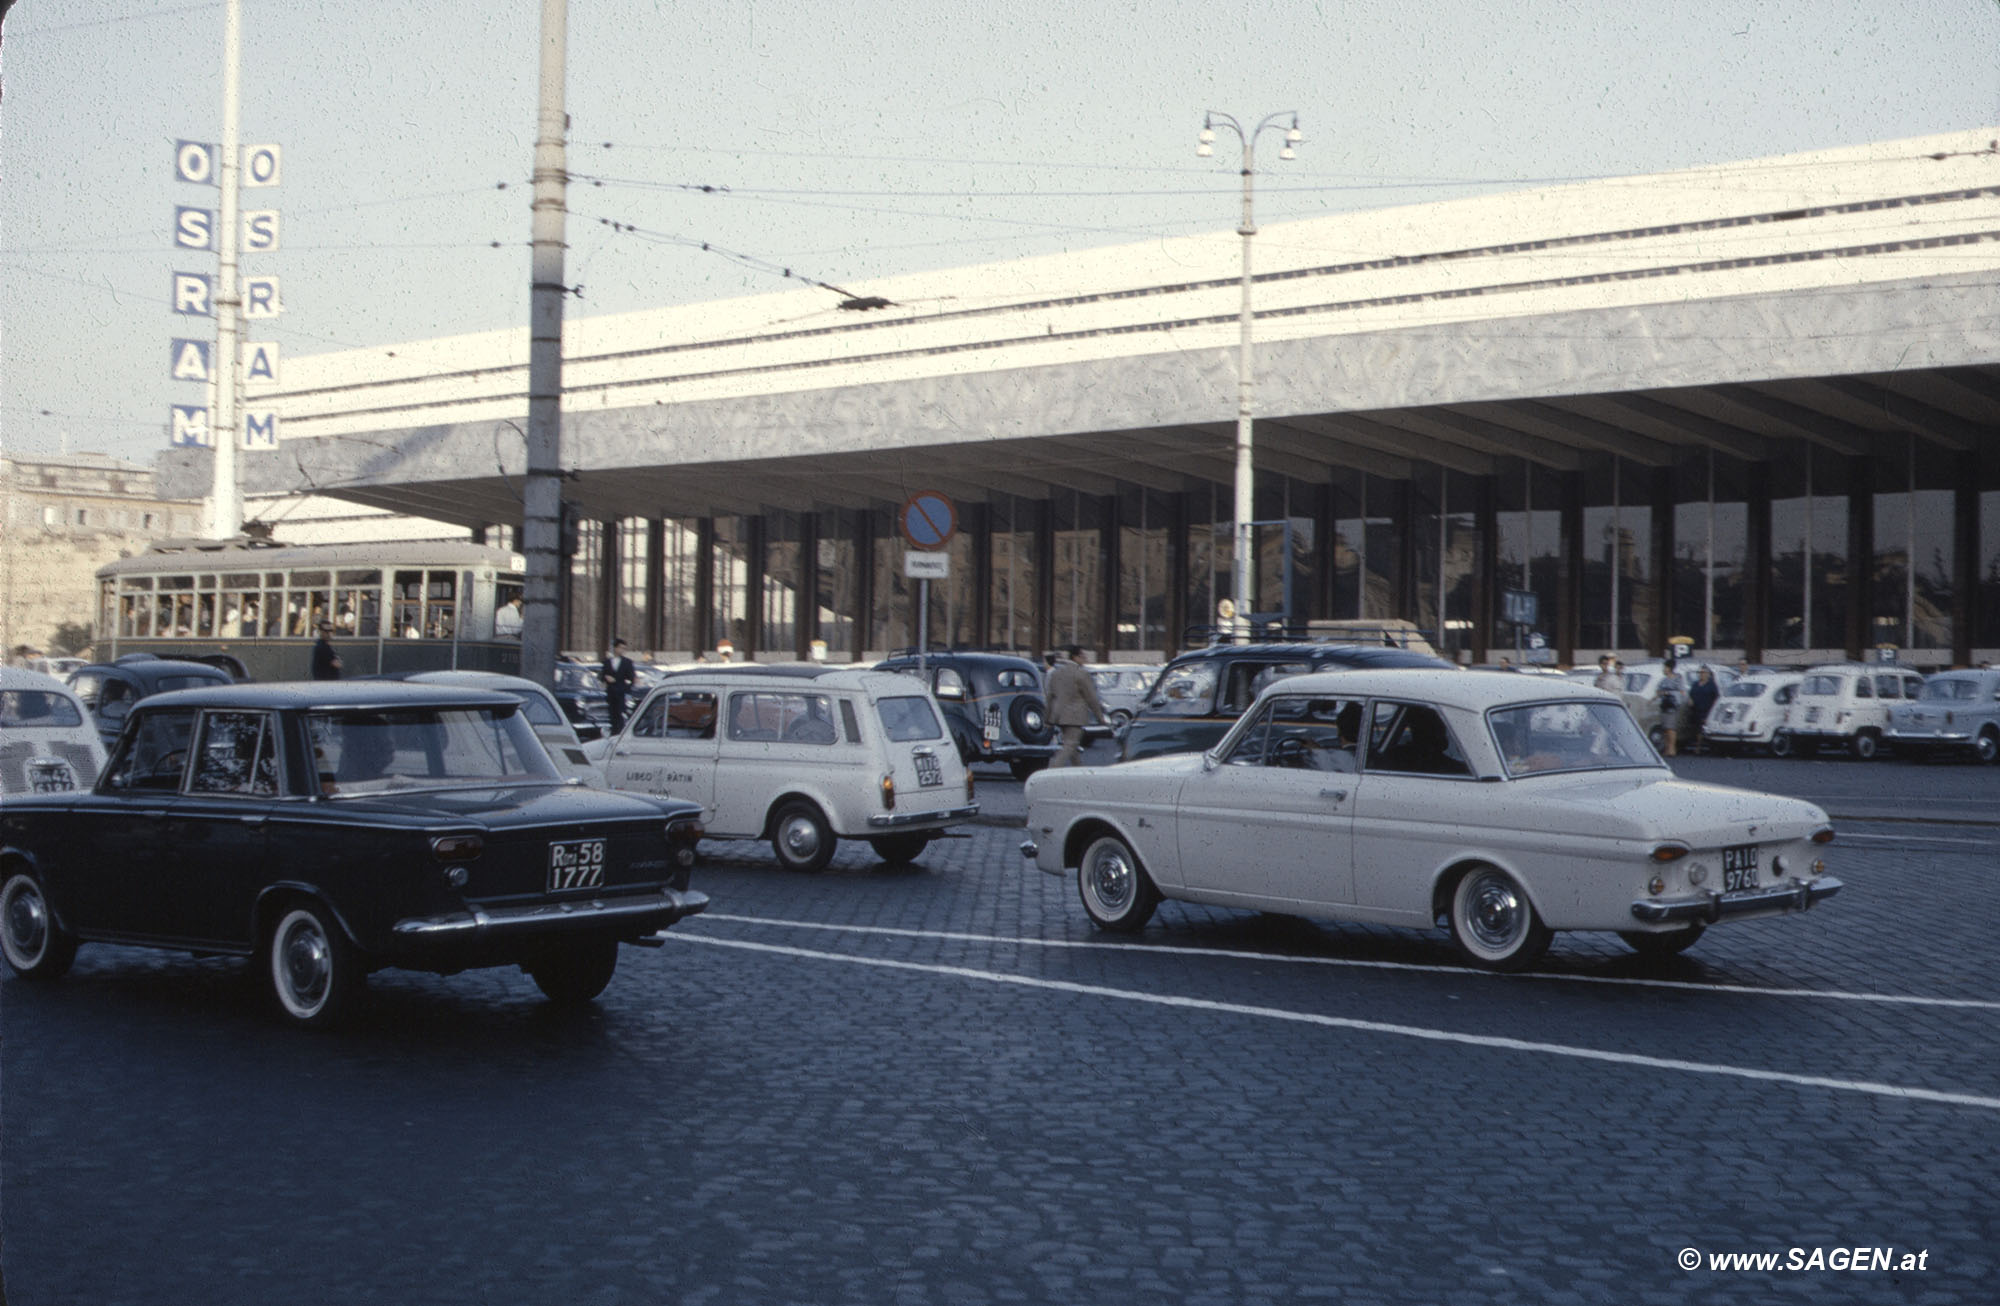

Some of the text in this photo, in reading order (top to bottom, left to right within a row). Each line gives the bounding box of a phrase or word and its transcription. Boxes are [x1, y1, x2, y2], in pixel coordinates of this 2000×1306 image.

[173, 143, 210, 444] OSRAM
[247, 149, 275, 446] OSRAM
[1674, 644, 1689, 658] P
[578, 842, 604, 864] 58
[553, 864, 602, 889] 1777
[1727, 867, 1760, 891] 9760
